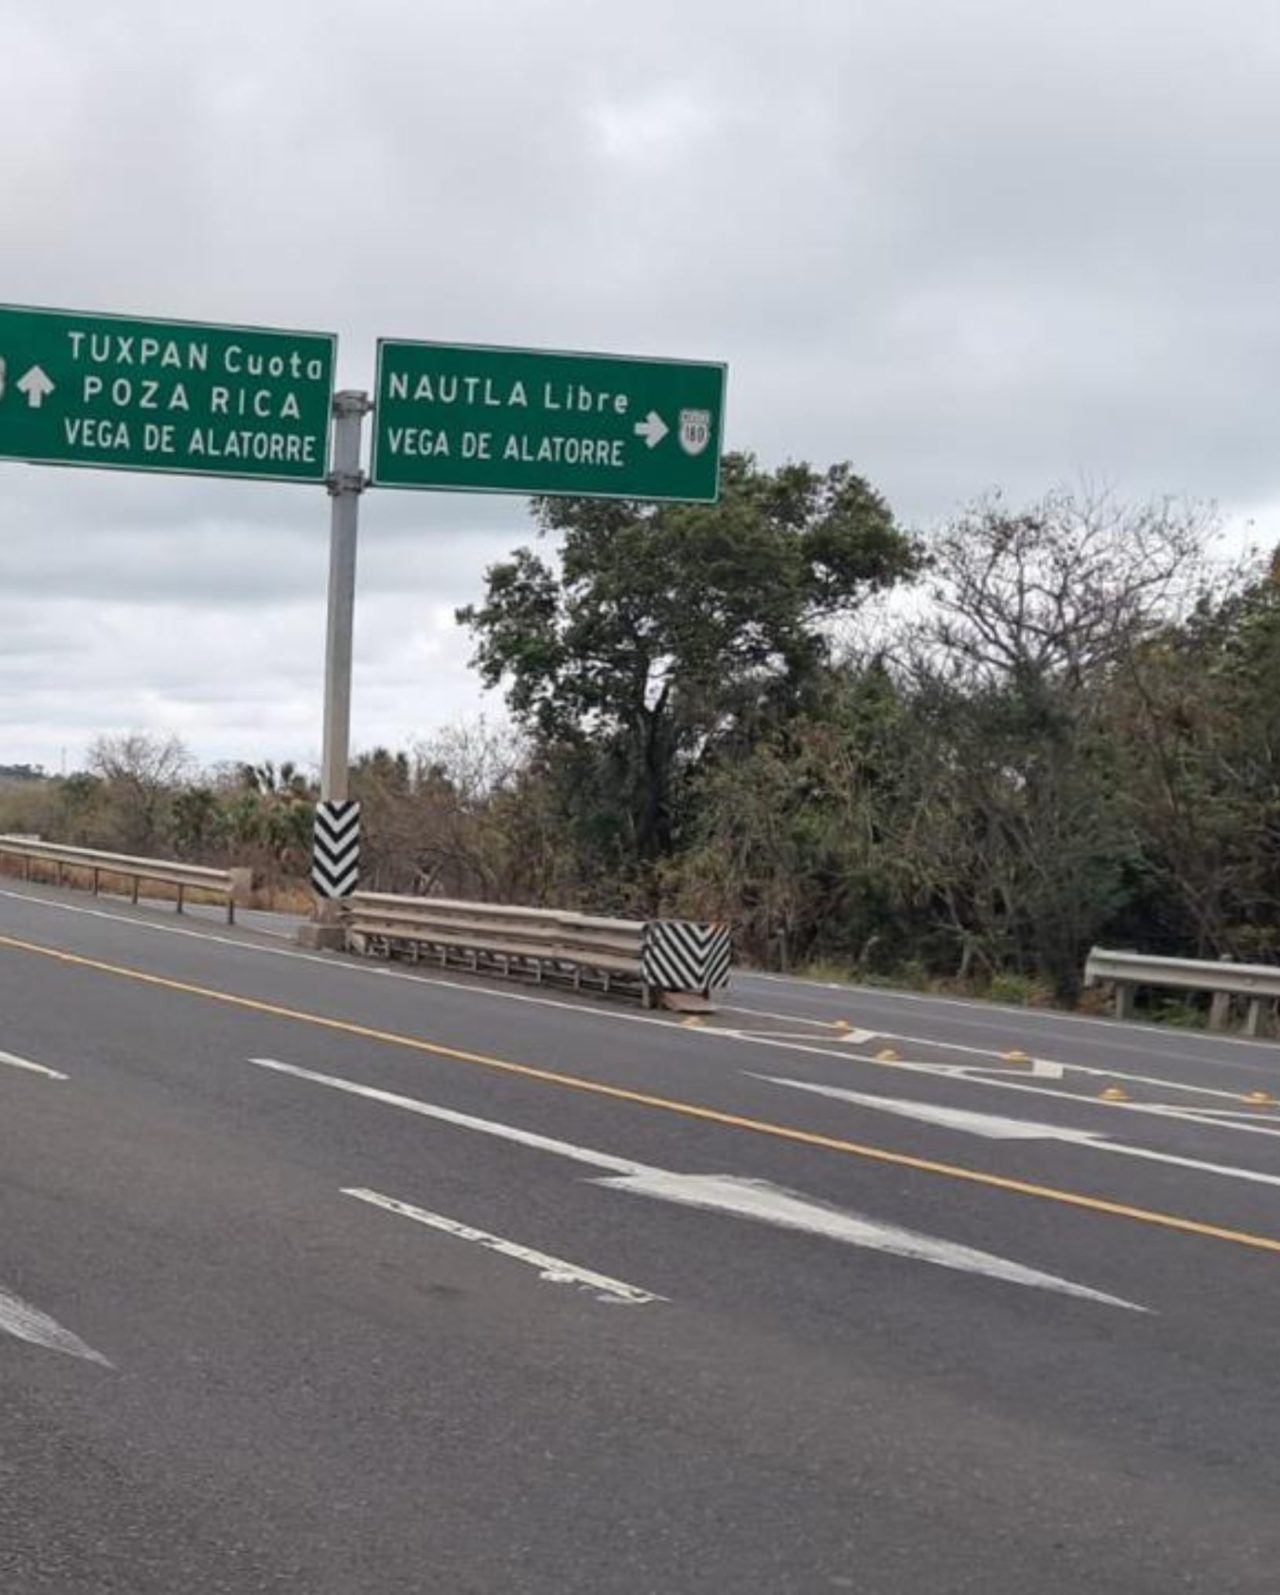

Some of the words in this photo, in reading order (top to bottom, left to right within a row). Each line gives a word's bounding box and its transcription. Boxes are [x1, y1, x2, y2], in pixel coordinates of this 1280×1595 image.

[68, 331, 207, 370] TUXPAN
[224, 345, 322, 380] Cuota
[83, 376, 189, 411] POZA
[211, 387, 300, 419] RICA
[388, 372, 527, 408] NAUTLA
[545, 383, 628, 414] Libre
[64, 417, 130, 450] VEGA
[143, 424, 176, 452] DE
[188, 431, 316, 462] ALATORRE
[388, 427, 450, 456] VEGA
[461, 431, 491, 459] DE
[503, 436, 624, 467] ALATORRE
